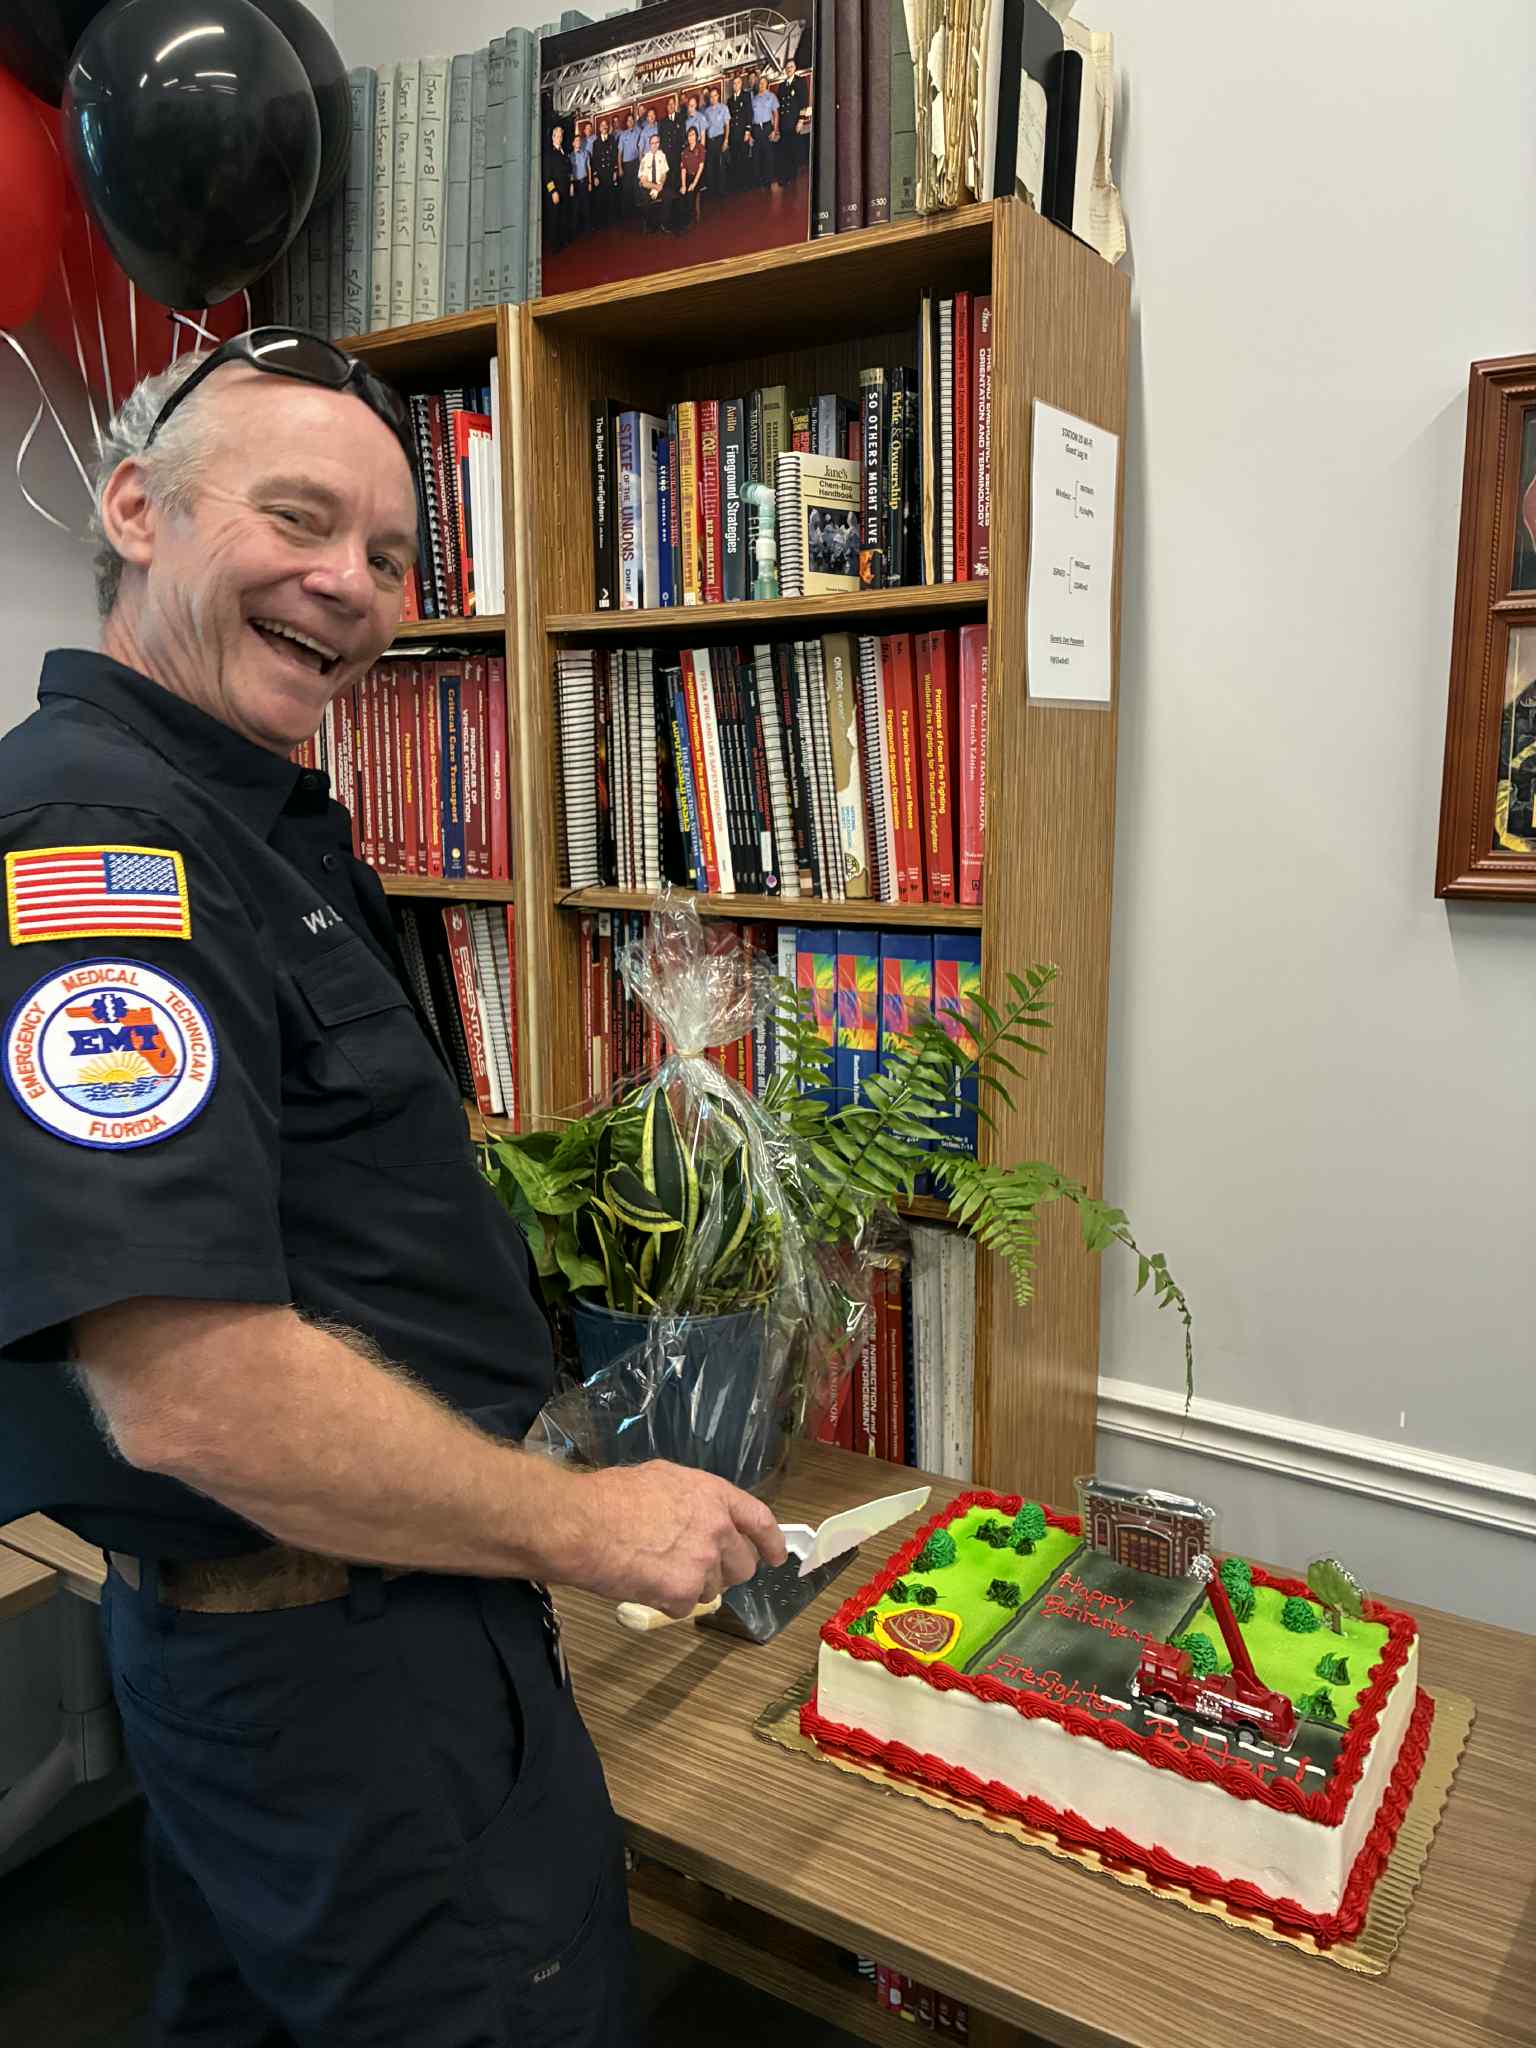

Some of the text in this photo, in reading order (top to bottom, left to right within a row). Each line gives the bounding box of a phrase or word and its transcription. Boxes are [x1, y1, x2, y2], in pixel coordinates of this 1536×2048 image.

[596, 416, 605, 433] The
[891, 391, 903, 425] Pride
[595, 435, 605, 457] Rights
[620, 423, 634, 473] STATE
[749, 410, 759, 456] SEBASTIAN
[977, 348, 986, 527] ORIENTATION AND TERMINOLOGY
[597, 458, 606, 473] of
[623, 474, 630, 486] OF
[724, 405, 740, 554] Avillo Fireground Strategies
[824, 465, 849, 480] Jane's
[867, 391, 879, 545] SO OTHERS MIGHT LIVE
[887, 439, 903, 510] Ownership
[436, 445, 453, 574] TO TERRORIST ATTACKS
[596, 474, 606, 522] Firefighters
[621, 506, 634, 562] UNIONS
[624, 568, 632, 593] DINE
[686, 672, 699, 713] Respiratory
[924, 673, 932, 708] Wildland
[690, 714, 703, 752] Protection
[885, 709, 896, 752] Fireground
[901, 710, 909, 726] Fire
[925, 709, 933, 724] Fire
[448, 688, 458, 823] Critical Care Transport
[902, 727, 911, 755] Service
[925, 725, 935, 758] Fighting
[934, 688, 947, 814] Principles of Foam Fire Fighting
[696, 762, 705, 776] Fire
[698, 777, 706, 790] and
[888, 753, 899, 785] Support
[968, 747, 977, 781] Edition
[463, 754, 471, 823] EXTRICATION
[928, 770, 938, 809] Structural
[930, 810, 940, 853] Firefighters
[60, 967, 141, 994] MEDICAL
[460, 946, 486, 1077] ESSENTIALS
[14, 1000, 48, 1100] EMERGENCY
[67, 1023, 160, 1057] EMT
[164, 990, 207, 1083] TECHNICIAN
[88, 1113, 167, 1140] FLORIDA
[861, 1347, 870, 1433] ENFORCEMENT
[869, 1343, 877, 1412] INSPECTION
[1058, 1572, 1134, 1617] Happy
[1039, 1593, 1154, 1645] Retirement
[985, 1653, 1126, 1714] Firefighter
